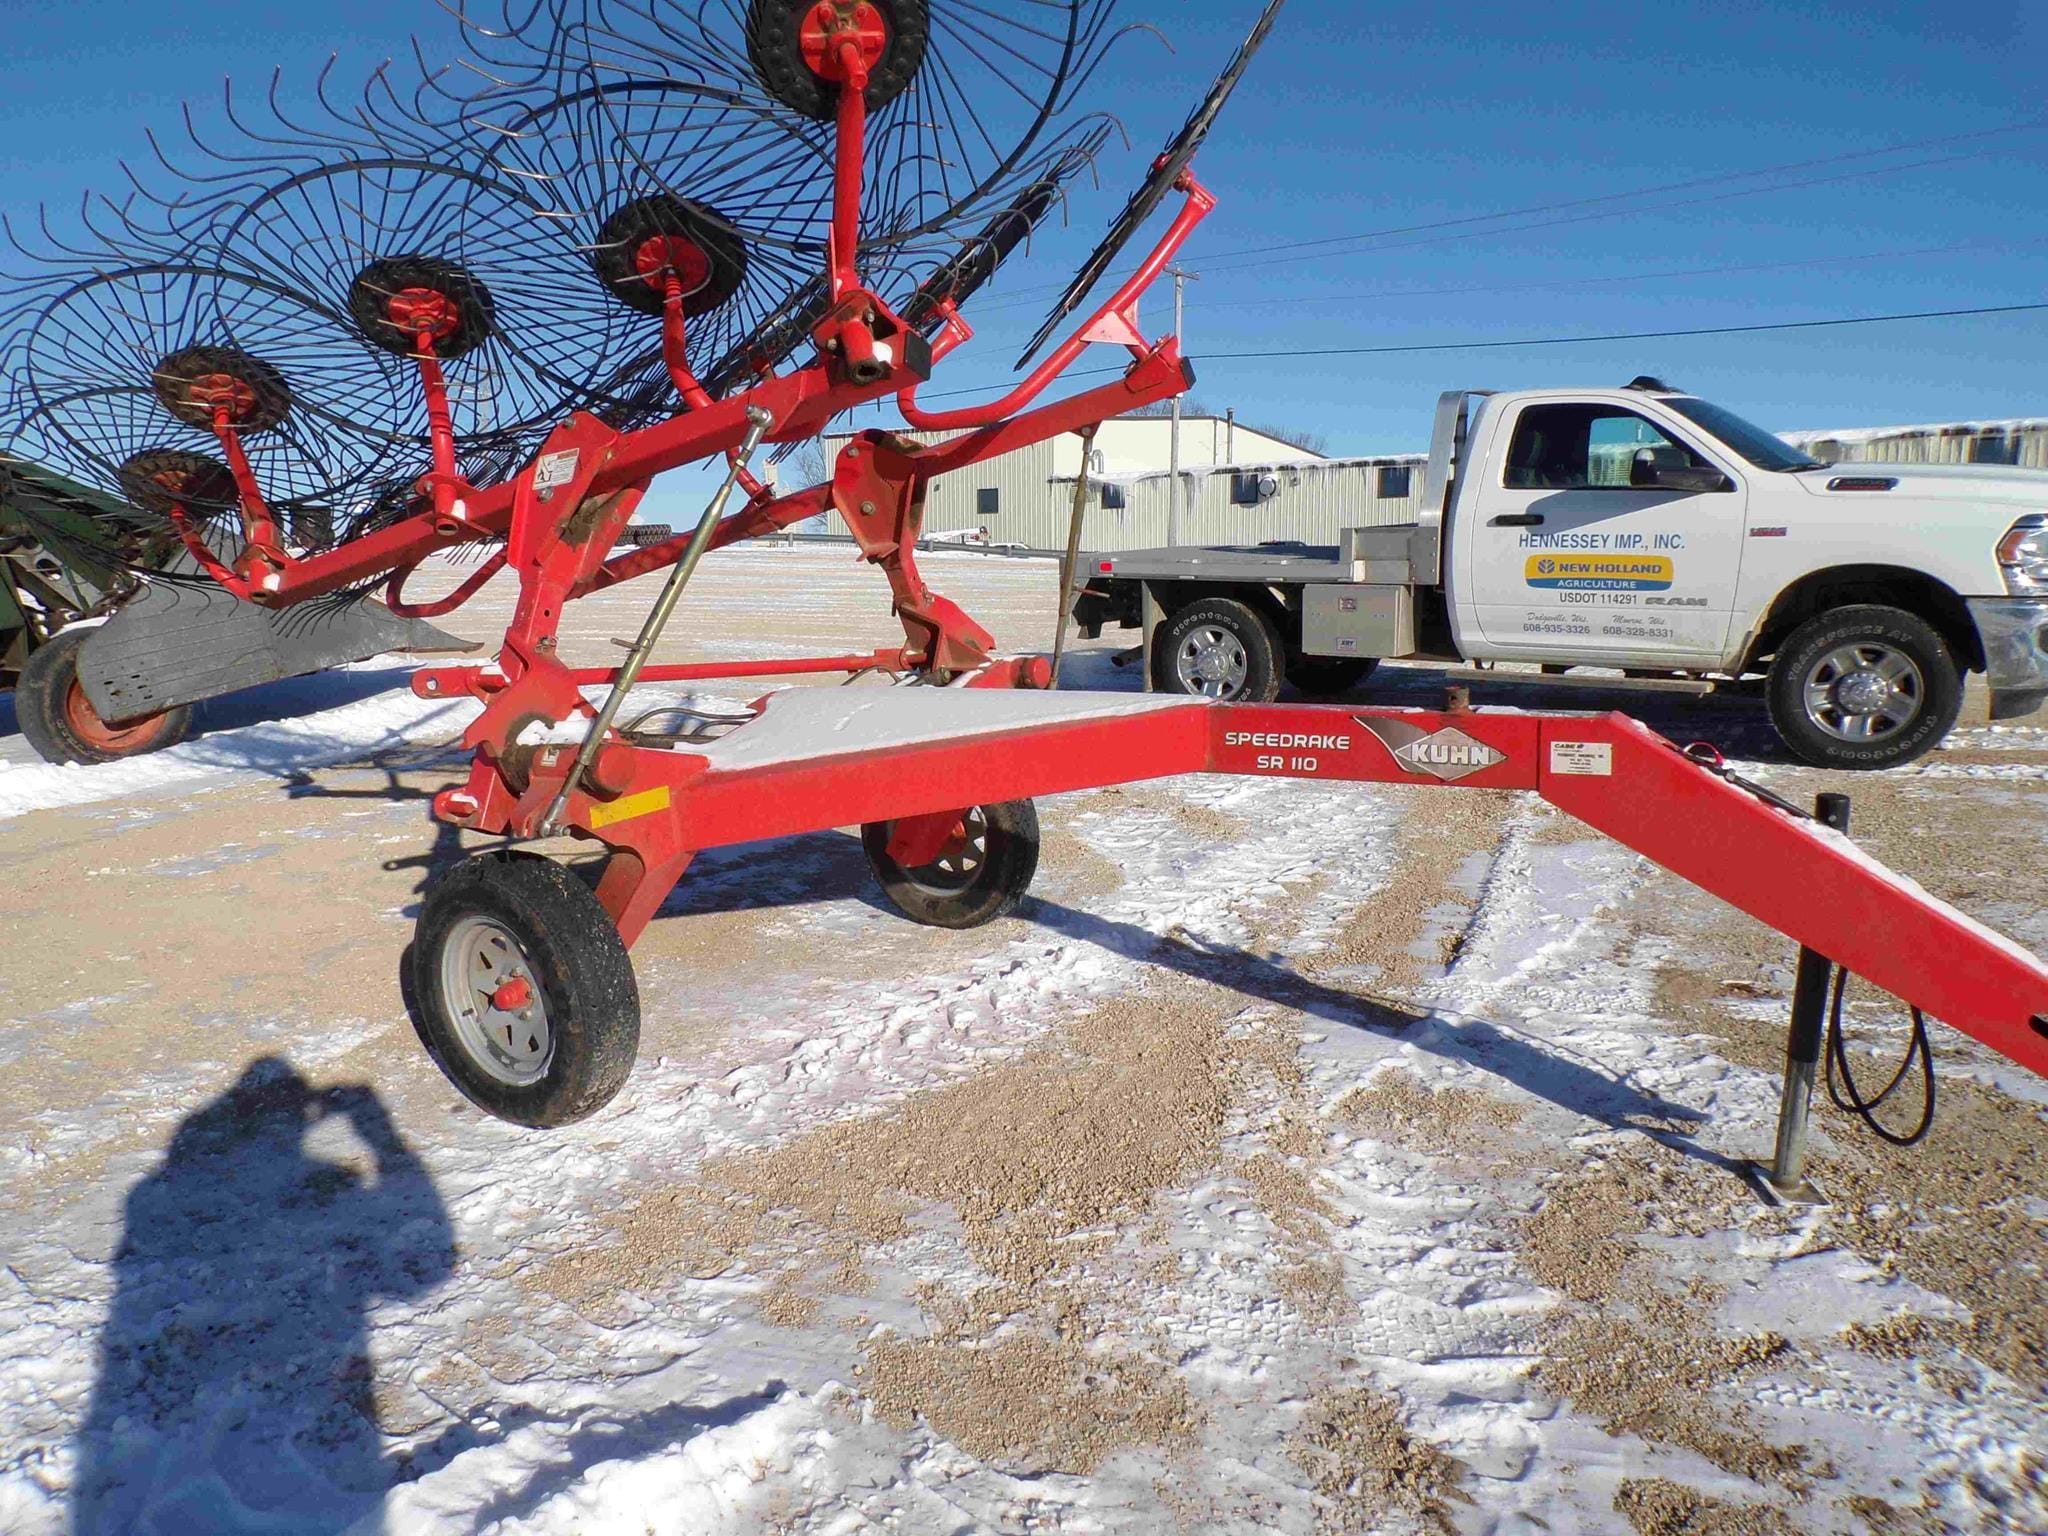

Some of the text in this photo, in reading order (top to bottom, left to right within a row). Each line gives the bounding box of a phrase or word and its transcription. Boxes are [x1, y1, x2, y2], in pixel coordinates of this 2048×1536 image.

[1519, 534, 1685, 551] HENNESSEY IMP., INC.
[1559, 564, 1662, 574] NEW HOLLAND
[1557, 579, 1637, 589] AGRICULTURE
[1559, 593, 1637, 605] USDOT 114291
[1523, 624, 1673, 638] 608-935-3326 608-328-8331
[1225, 732, 1350, 750] SPEEDRAKE
[1411, 744, 1489, 765] KUHN
[1257, 755, 1317, 771] SR 110
